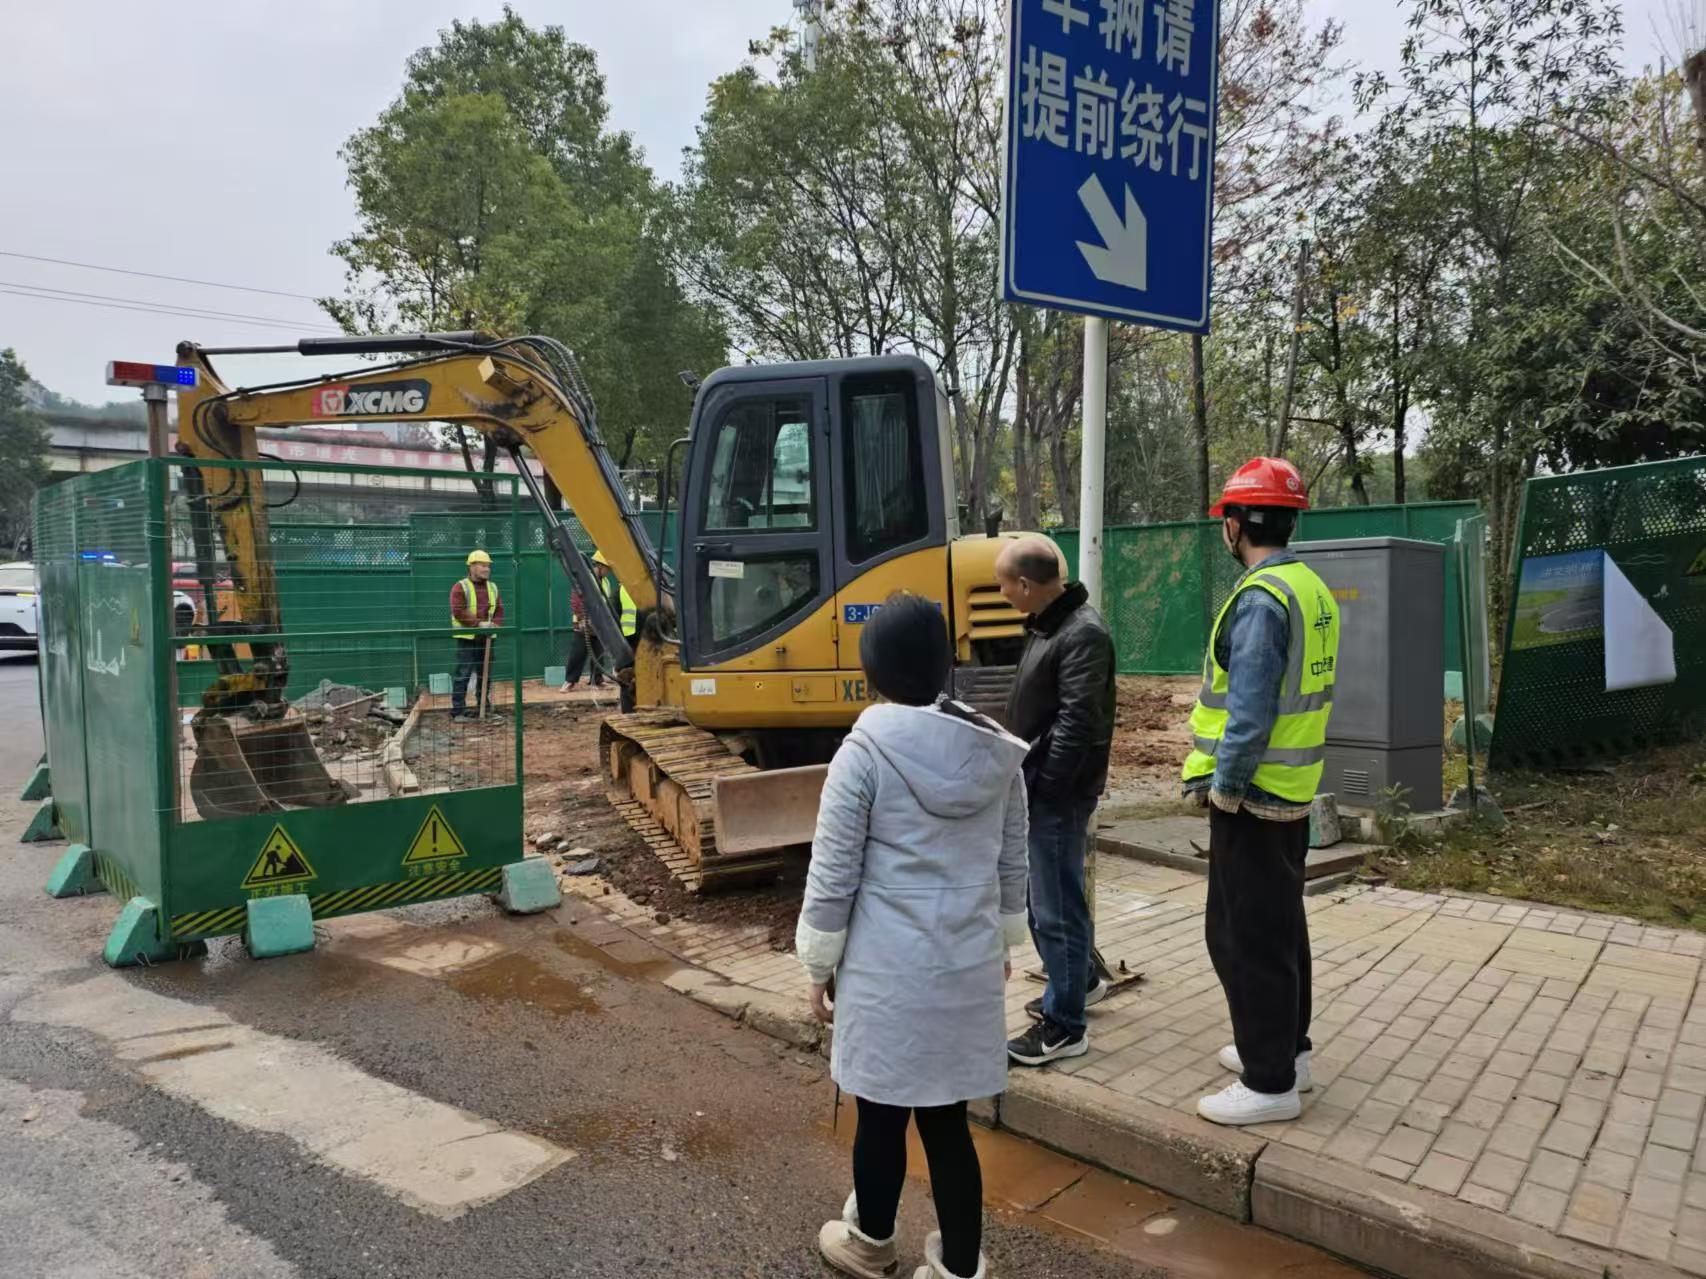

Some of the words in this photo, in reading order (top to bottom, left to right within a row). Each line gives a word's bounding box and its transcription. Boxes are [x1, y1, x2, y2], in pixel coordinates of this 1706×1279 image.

[1021, 45, 1208, 180] 提前绕行
[344, 389, 424, 414] XCMG
